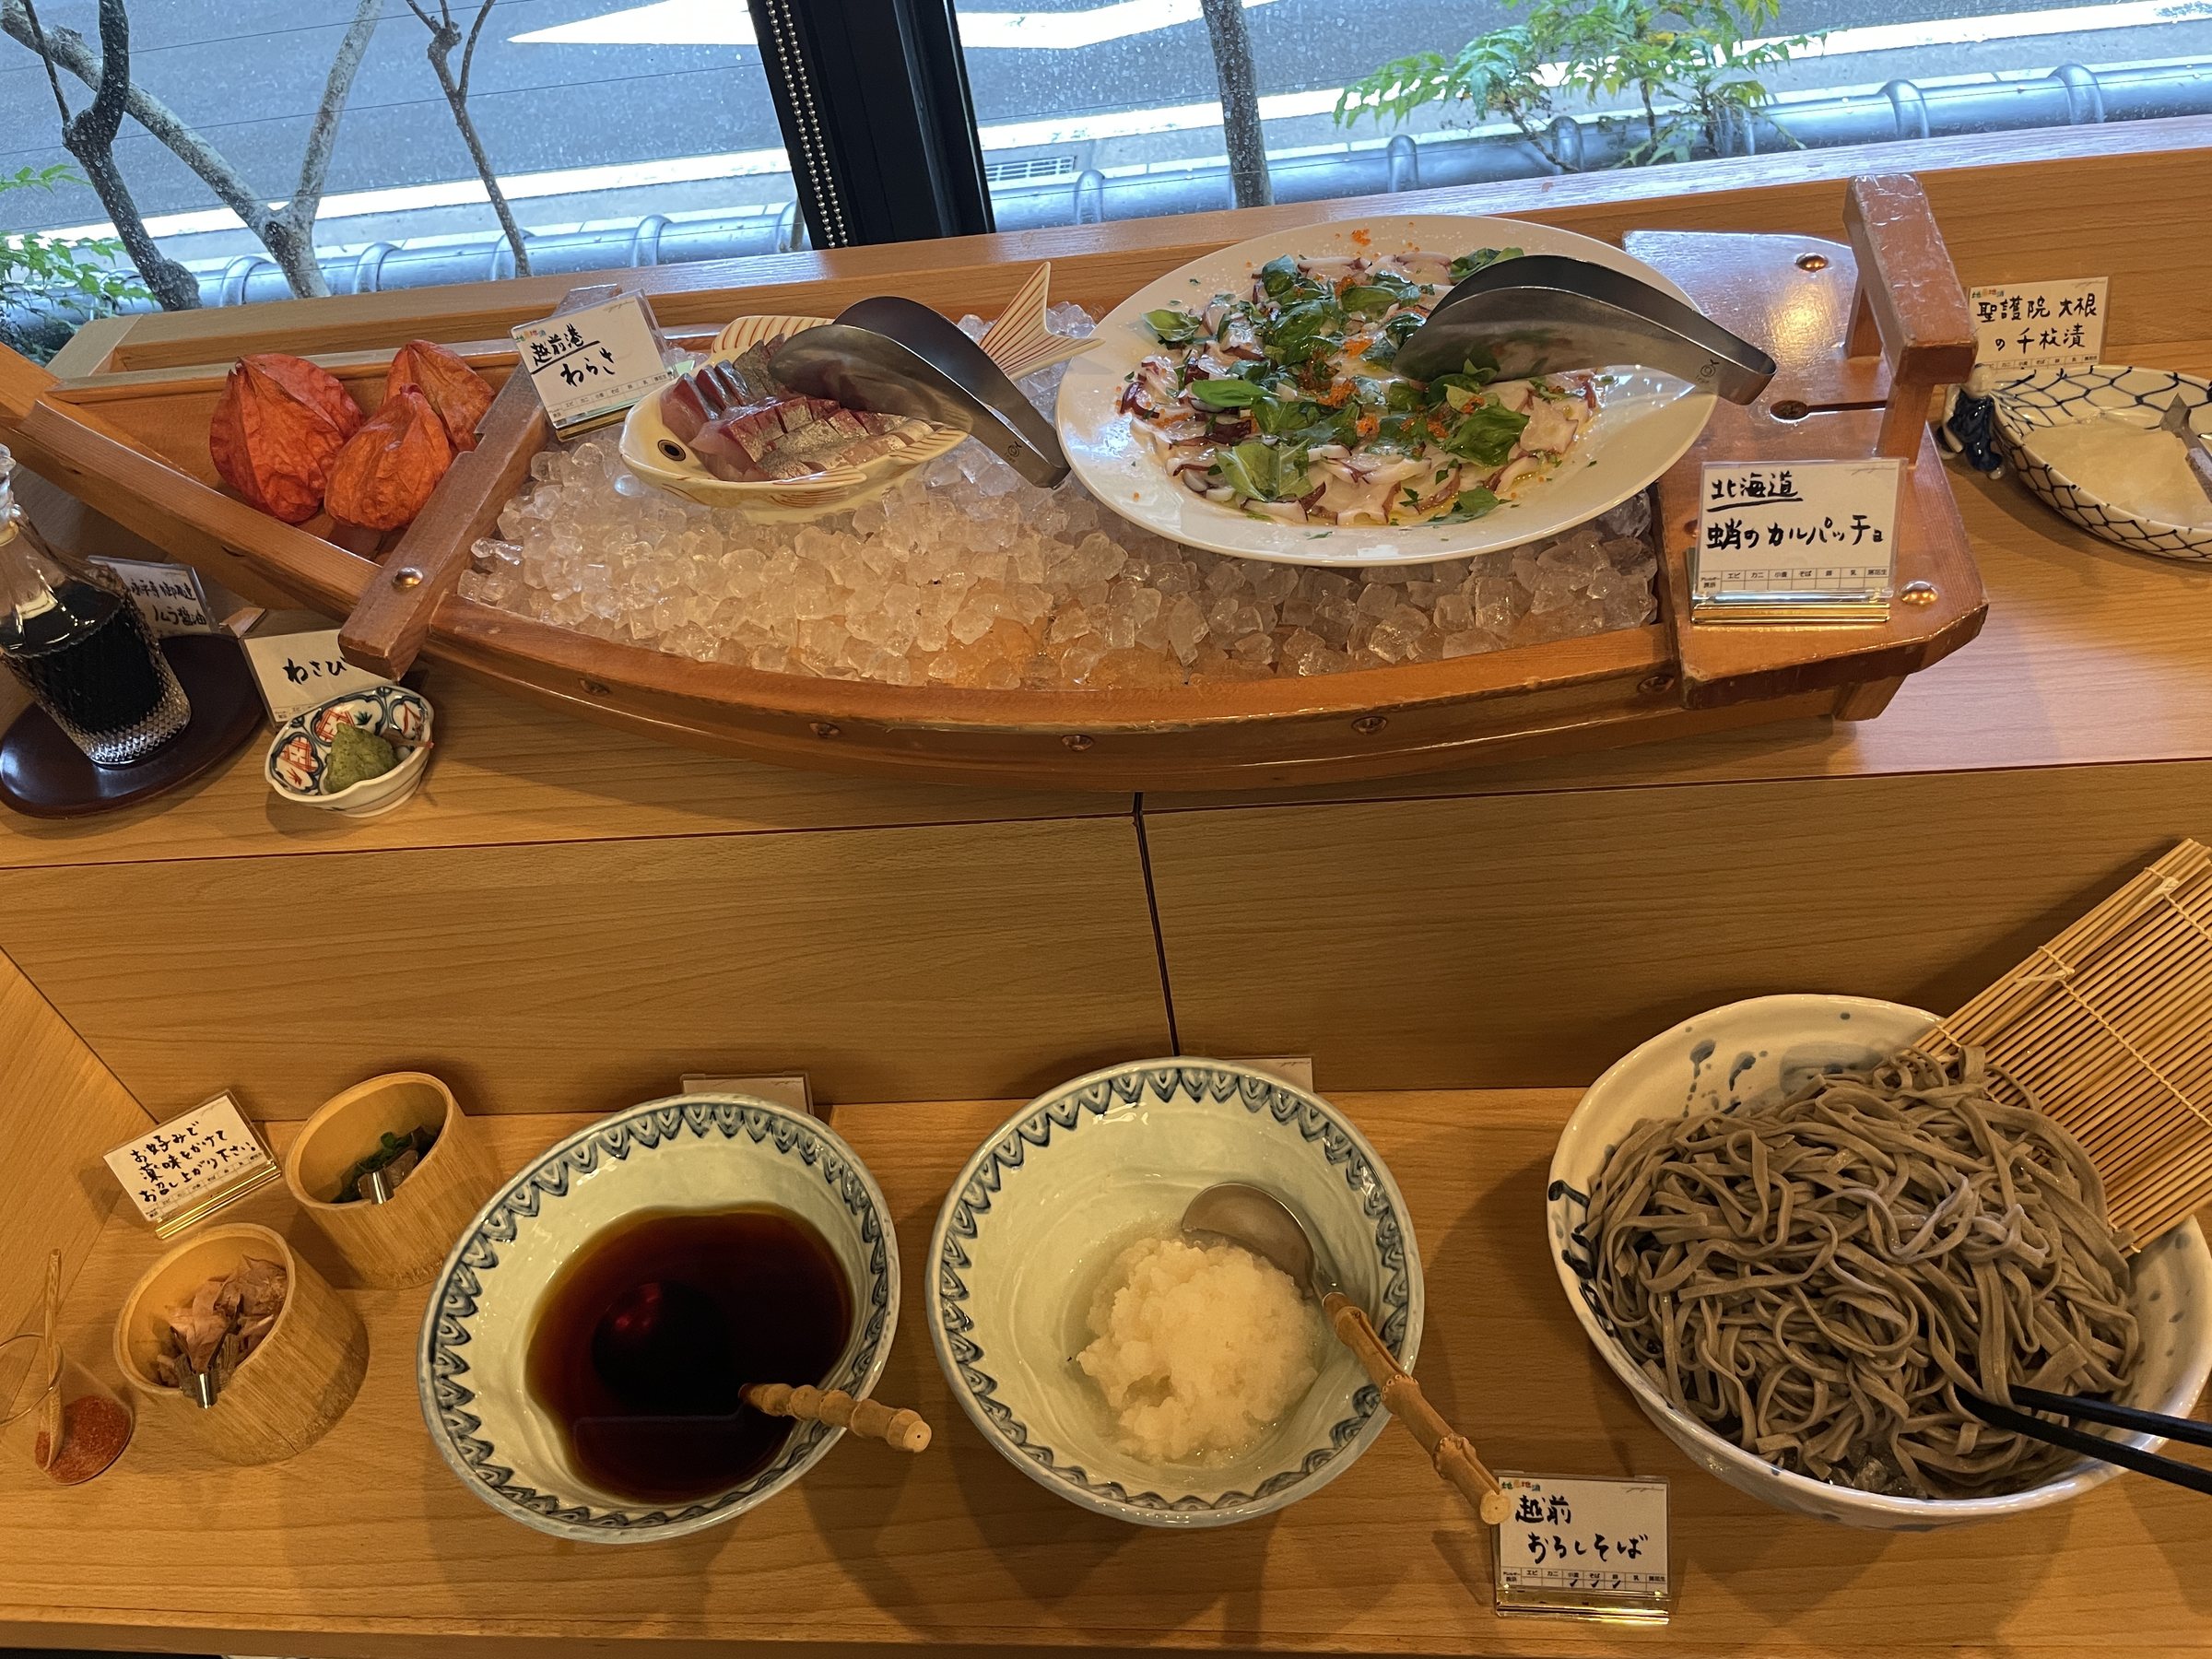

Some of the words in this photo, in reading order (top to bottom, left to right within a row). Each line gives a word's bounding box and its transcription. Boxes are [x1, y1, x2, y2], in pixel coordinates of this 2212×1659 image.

[530, 323, 584, 367] 越前港
[1712, 470, 1798, 500] 北海道
[1707, 514, 1884, 550] 蛸のカルパッチョ
[282, 657, 347, 685] わさび
[130, 1121, 199, 1163] お好みで
[139, 1130, 228, 1182] 薬味をかけて
[1515, 1494, 1571, 1525] 越前
[1528, 1532, 1648, 1564] おろしそば
